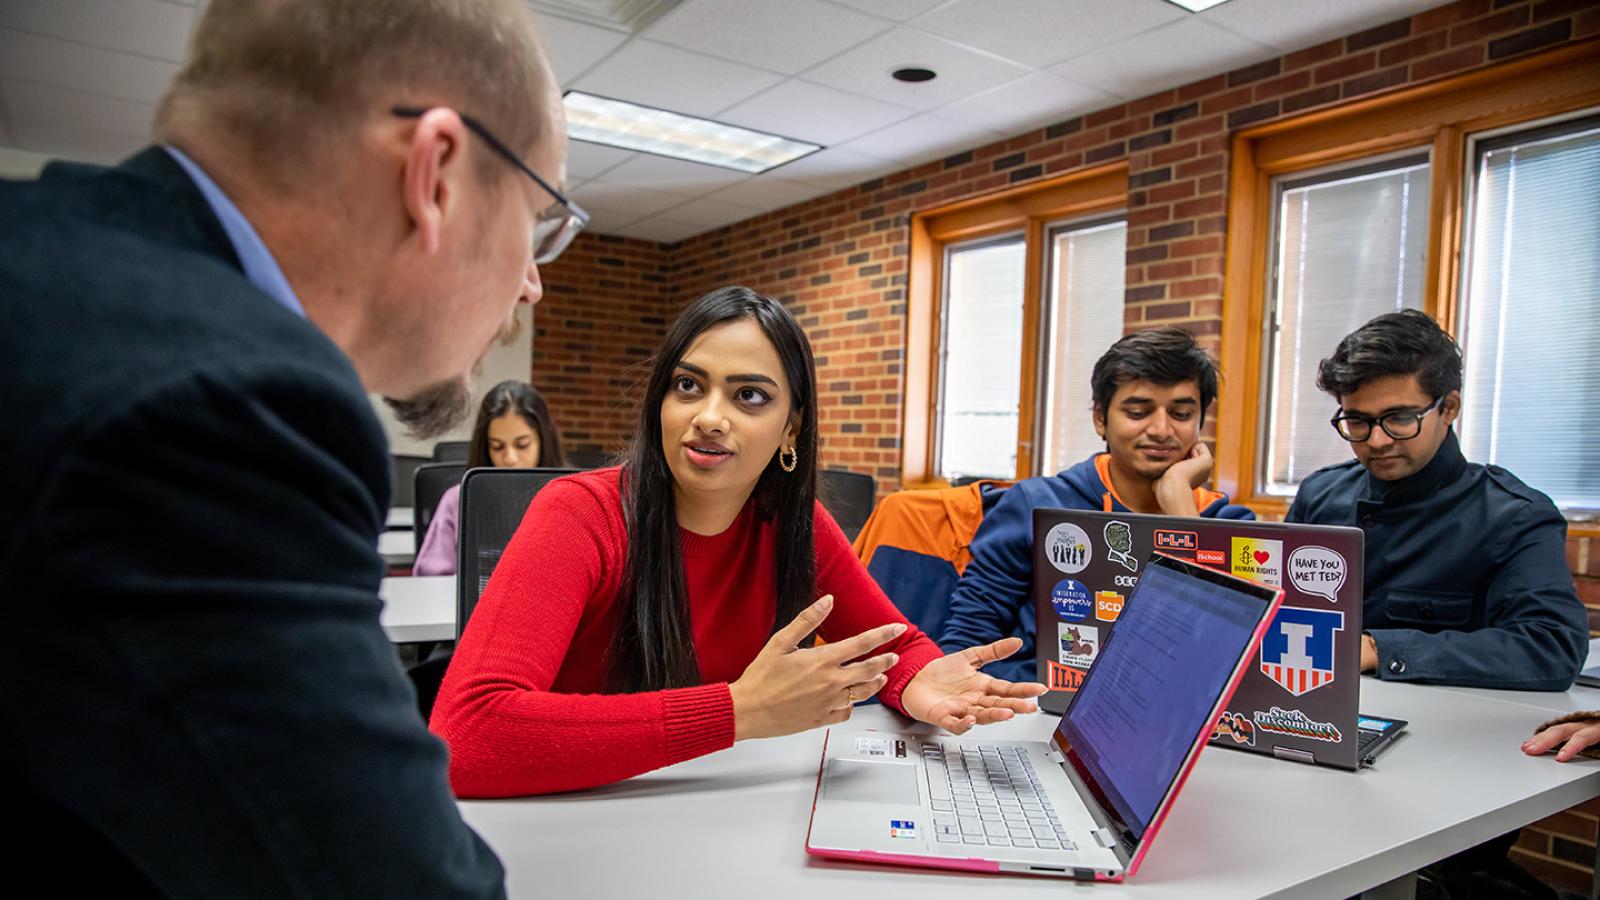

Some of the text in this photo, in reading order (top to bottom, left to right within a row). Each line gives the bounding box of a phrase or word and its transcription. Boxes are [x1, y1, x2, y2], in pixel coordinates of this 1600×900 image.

[1295, 558, 1339, 570] HAVE YOU
[1234, 565, 1278, 576] HUMAN RIGHTS
[1295, 572, 1342, 582] MET TED?
[1098, 601, 1122, 612] SCD
[1257, 712, 1331, 732] Discomfort
